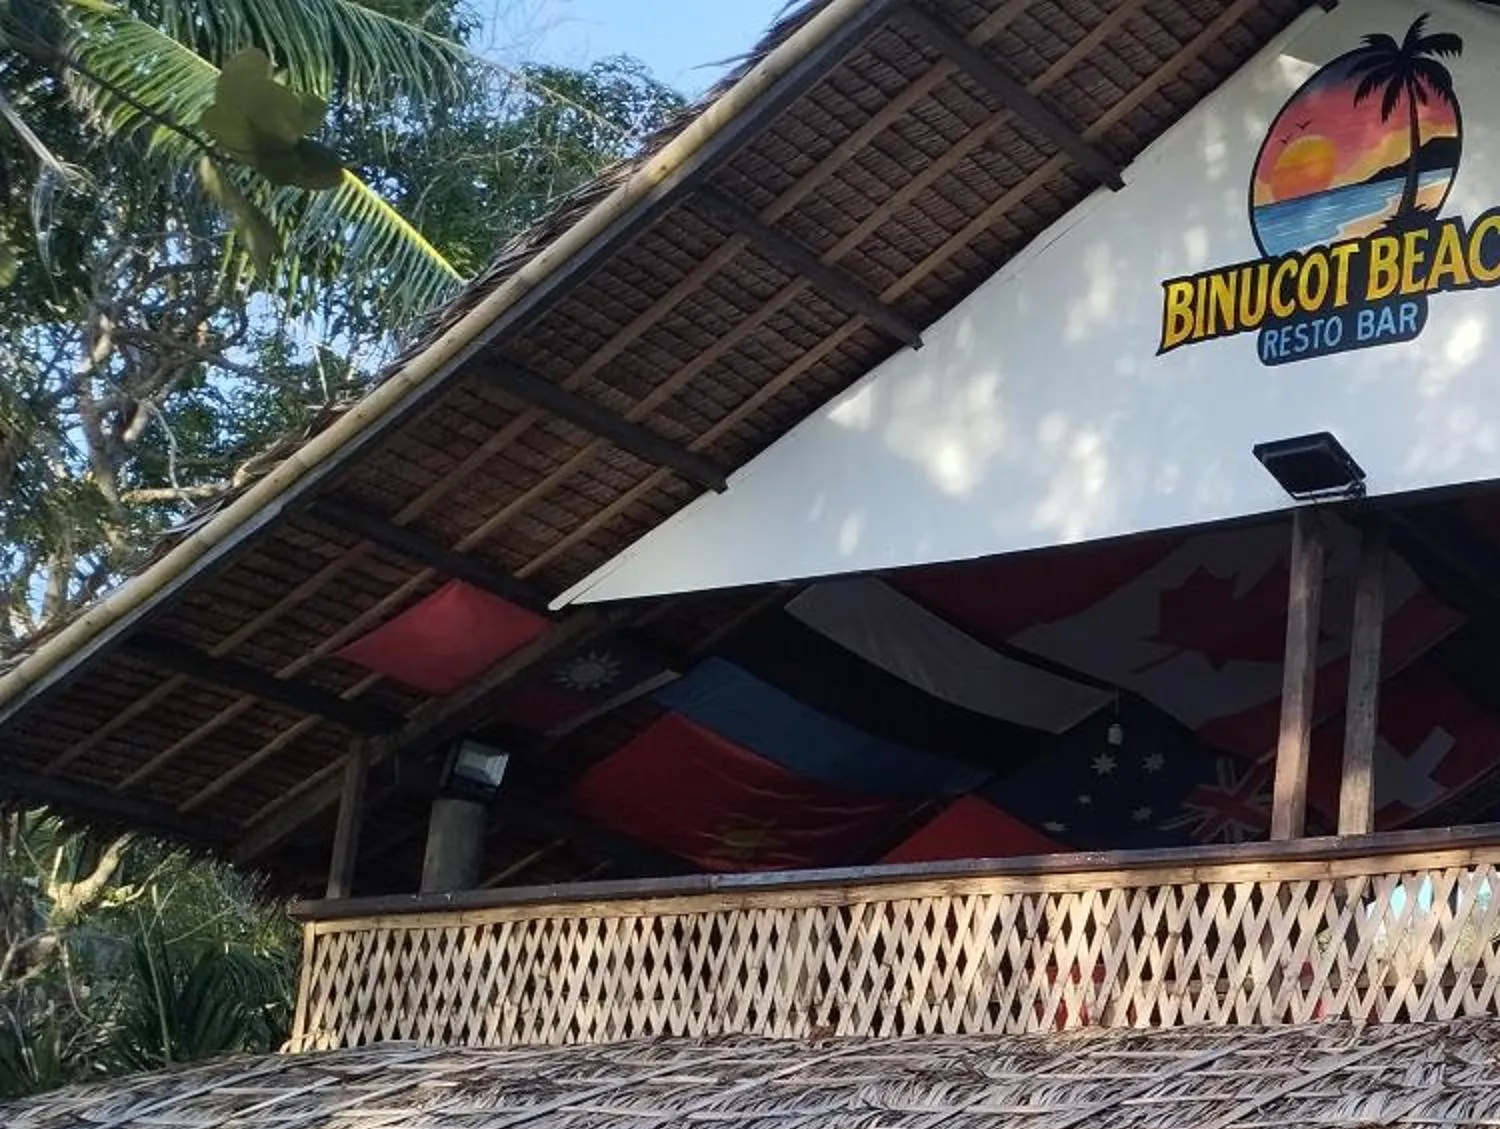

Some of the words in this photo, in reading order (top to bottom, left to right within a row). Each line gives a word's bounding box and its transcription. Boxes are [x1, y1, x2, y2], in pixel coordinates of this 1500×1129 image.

[1163, 243, 1360, 350] BINUCOT
[1262, 315, 1343, 360] RESTO
[1356, 302, 1419, 342] BAR
